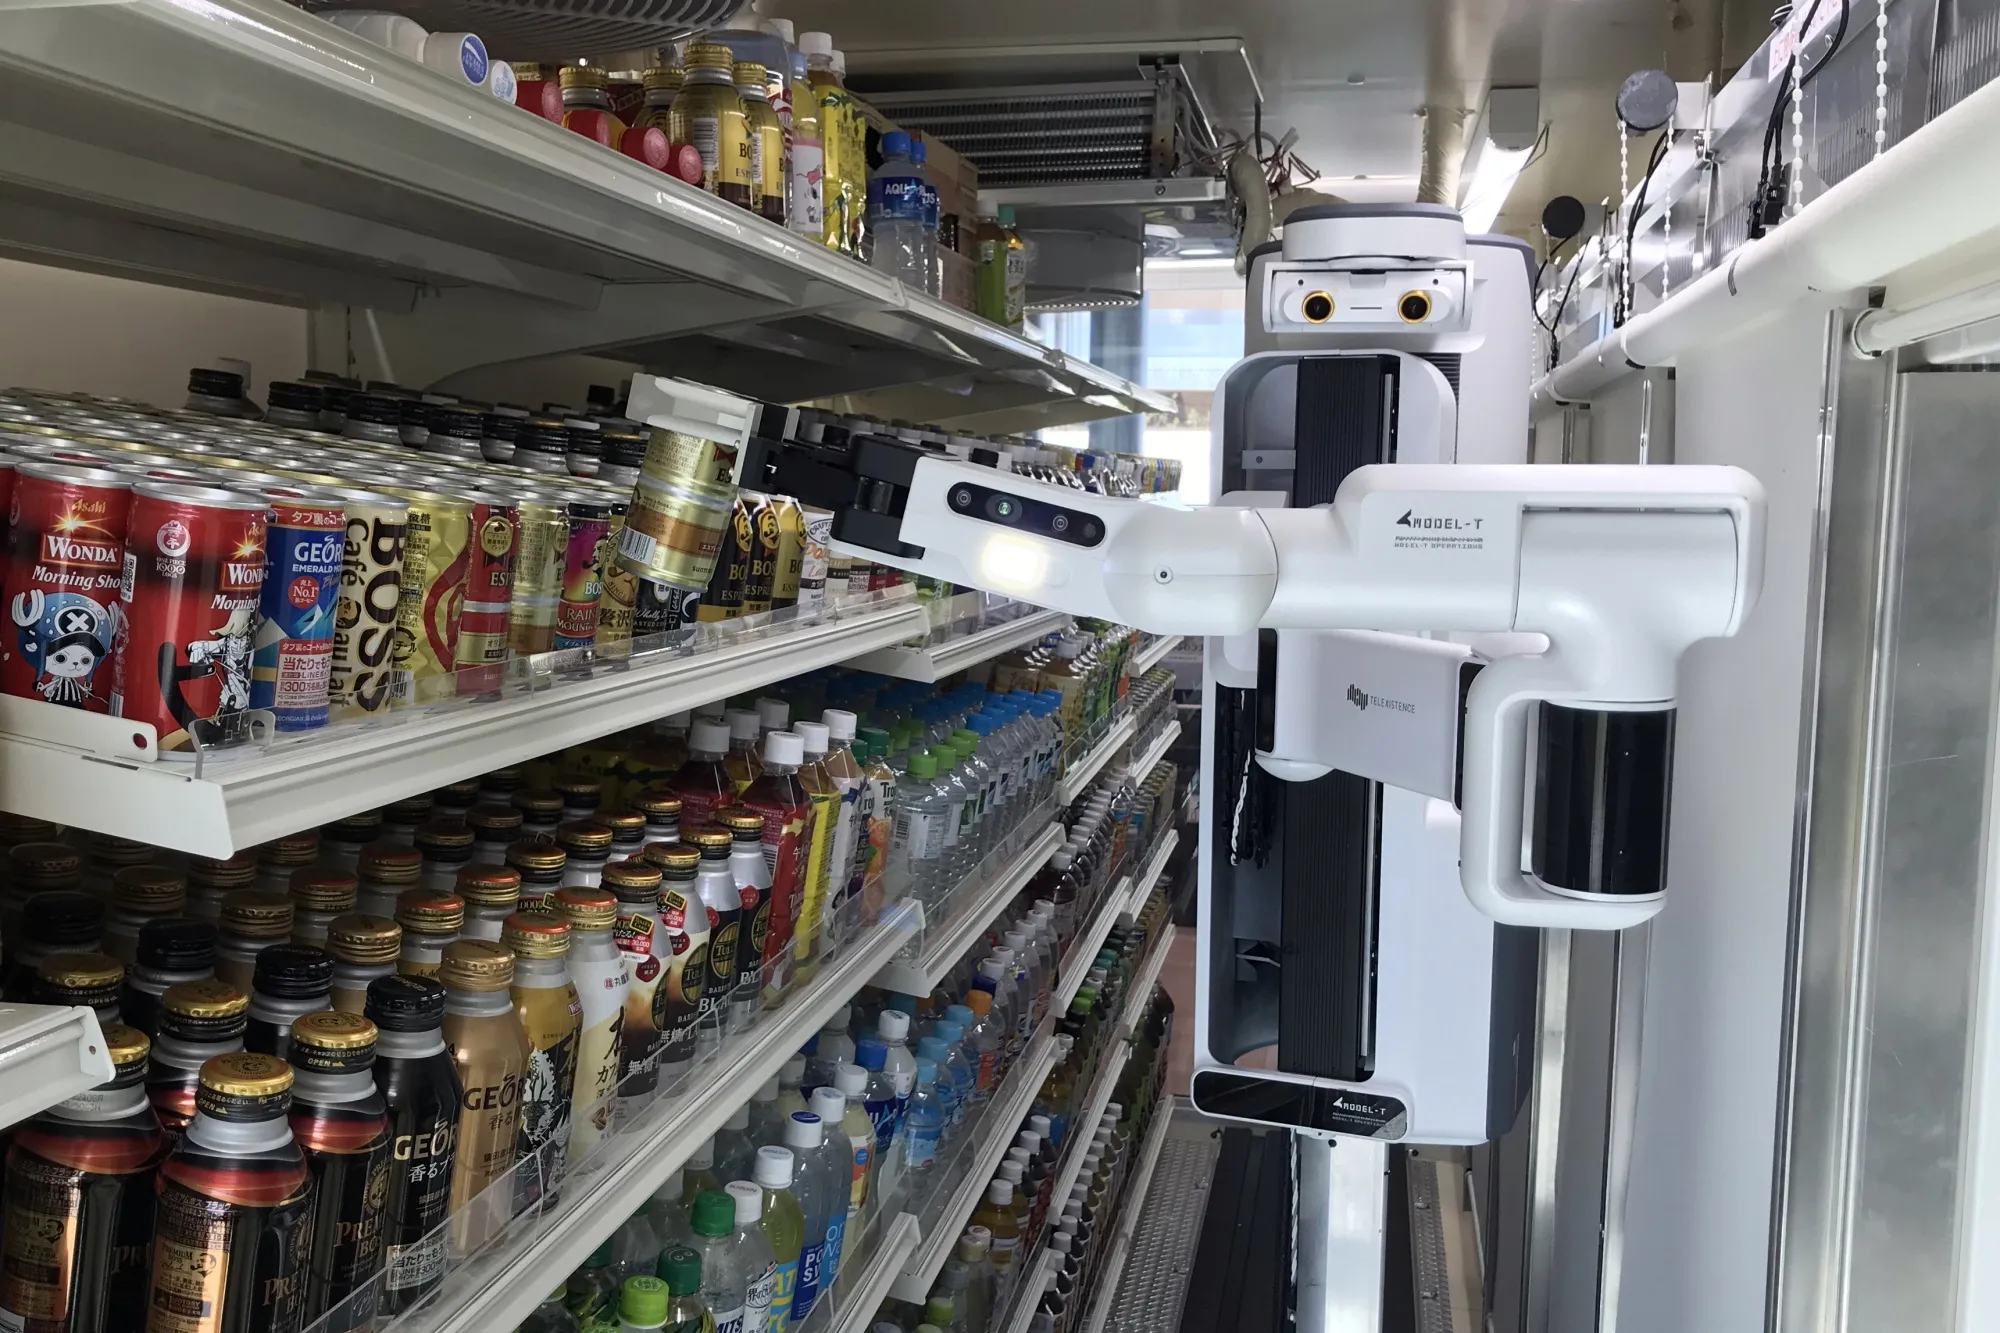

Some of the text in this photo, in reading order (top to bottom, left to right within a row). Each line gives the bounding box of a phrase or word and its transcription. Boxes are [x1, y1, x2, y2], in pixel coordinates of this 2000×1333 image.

[72, 499, 107, 514] Asahi
[1412, 517, 1484, 530] MODEL-T
[47, 535, 117, 563] WONDA
[292, 563, 333, 573] EMERALD
[32, 565, 121, 590] Morning Sho
[1369, 695, 1416, 715] TELEXISTENCE
[880, 781, 896, 797] Tro
[307, 1058, 331, 1067] OPEN
[1342, 1102, 1387, 1116] MODEL-T
